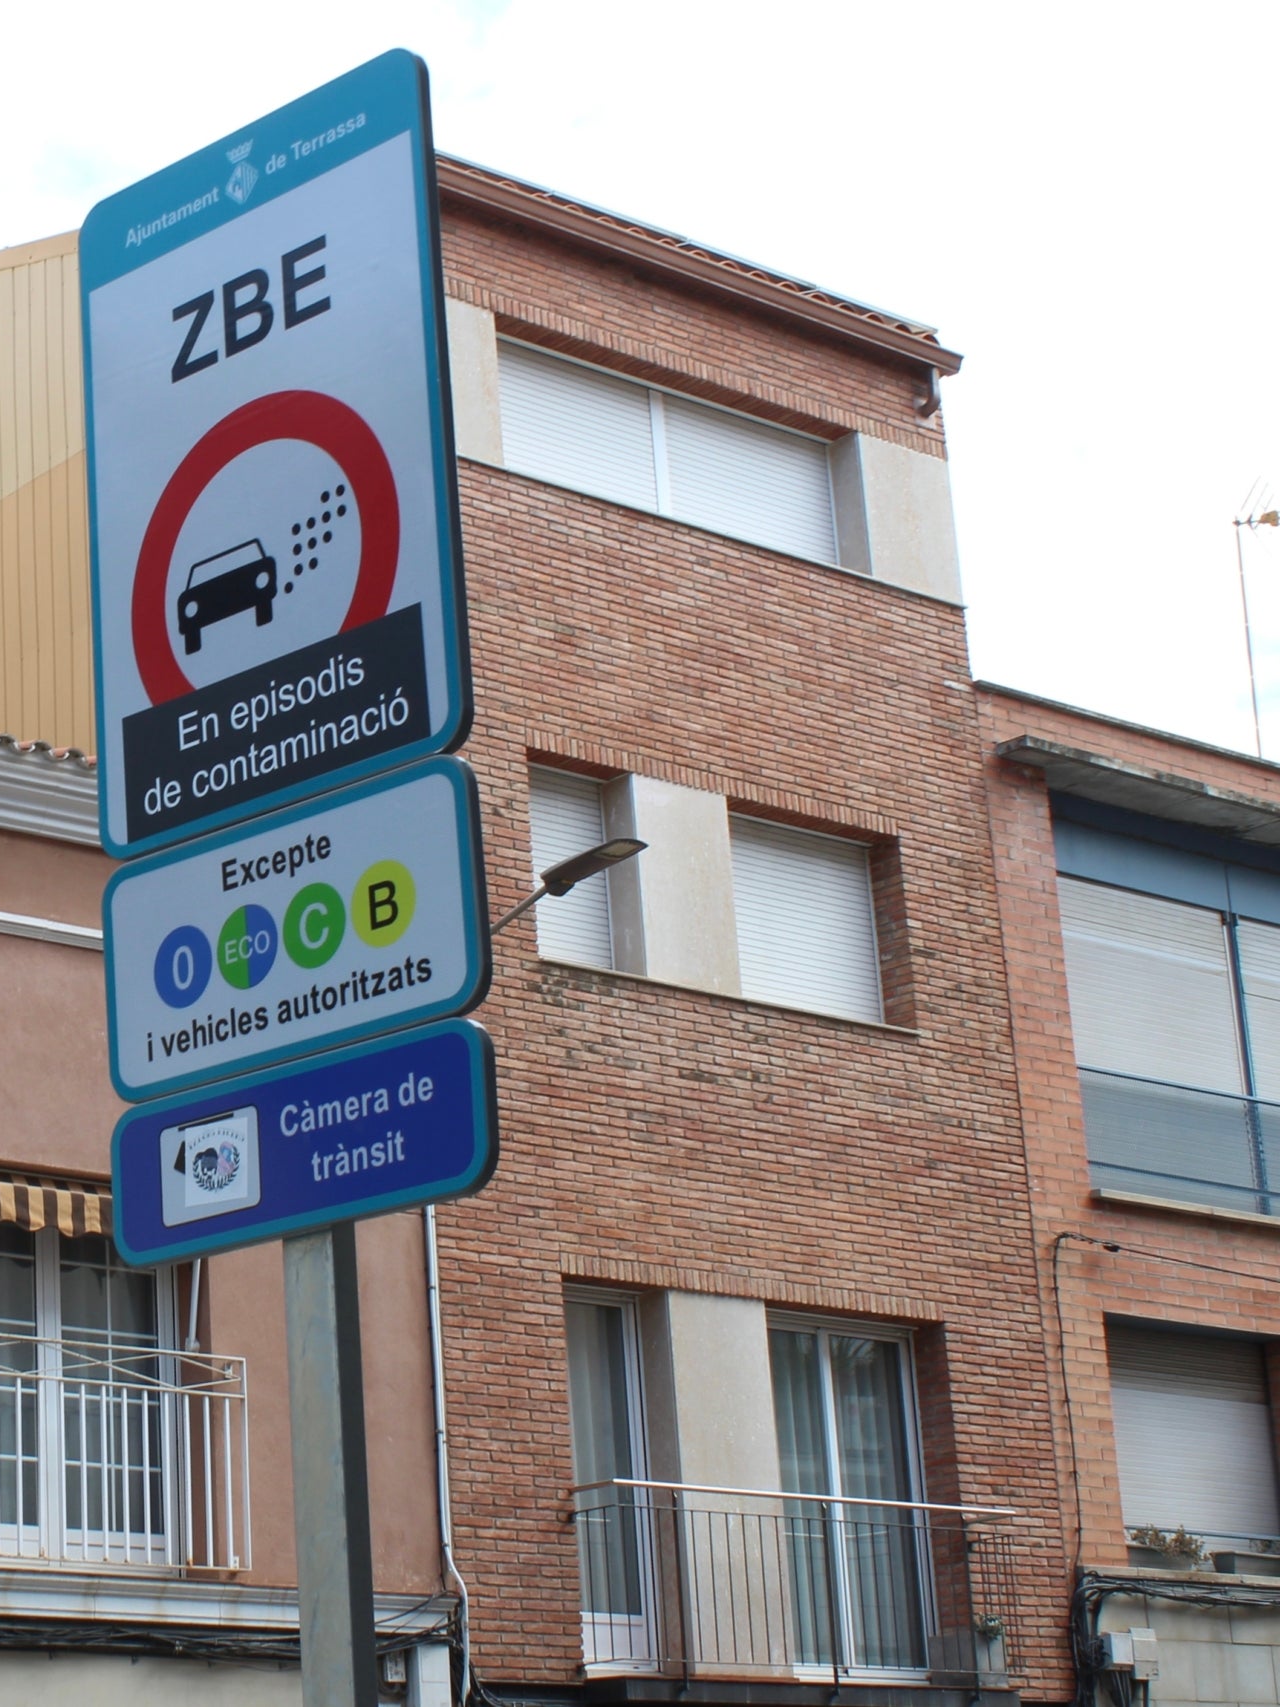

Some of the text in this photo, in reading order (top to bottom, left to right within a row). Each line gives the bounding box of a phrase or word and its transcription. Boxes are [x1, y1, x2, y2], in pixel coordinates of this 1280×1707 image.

[125, 112, 366, 248] Ajuntament de Terrassa
[171, 234, 332, 384] ZBE
[144, 687, 409, 815] de contaminació
[178, 654, 365, 751] En episodis
[221, 834, 331, 892] Excepte
[224, 930, 270, 965] ECO
[299, 902, 328, 949] C
[368, 880, 399, 931] B
[146, 956, 432, 1062] i vehicles autoritzats
[280, 1072, 434, 1137] Càmera de
[311, 1129, 405, 1182] trànsit
